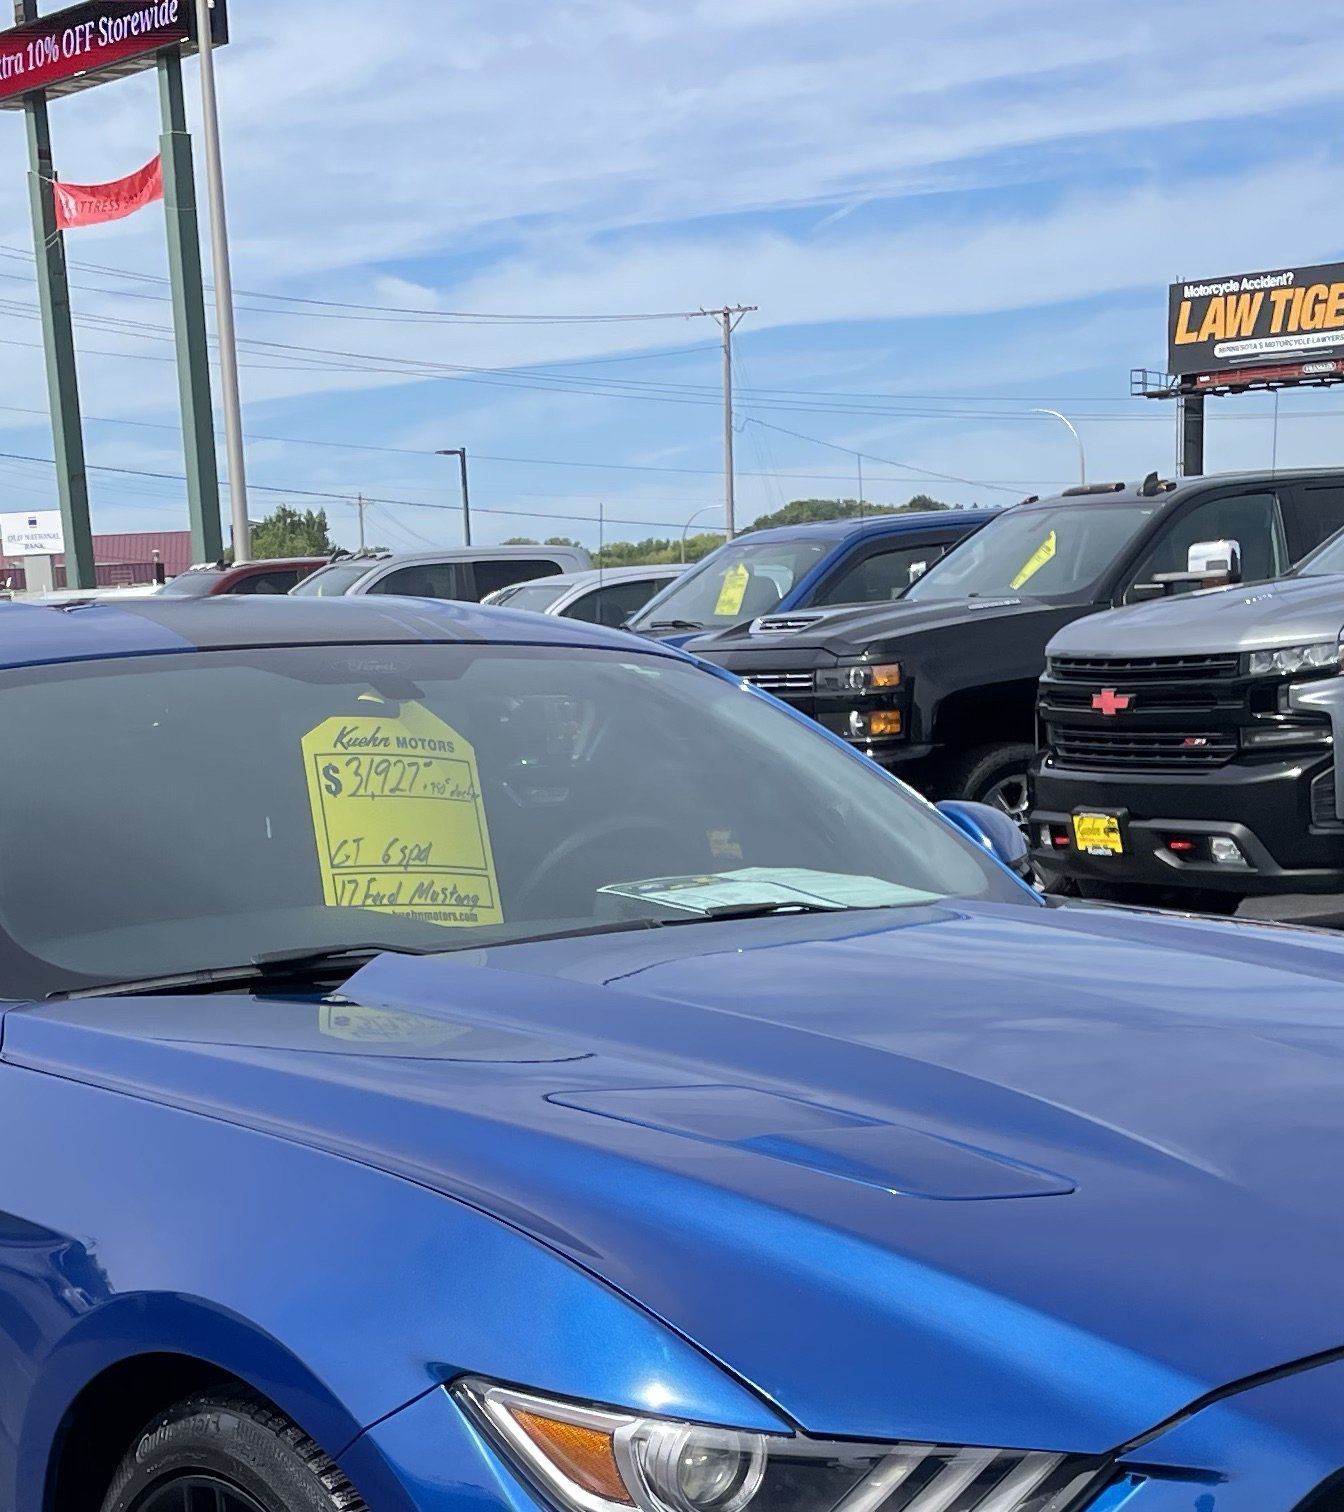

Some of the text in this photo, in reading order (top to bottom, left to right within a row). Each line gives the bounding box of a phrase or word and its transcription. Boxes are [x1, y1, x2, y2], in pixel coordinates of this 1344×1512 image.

[26, 33, 60, 71] 10%
[62, 20, 95, 58] OFF
[97, 0, 179, 48] Storewide
[1183, 271, 1295, 299] Motorcycle Accident?
[1174, 291, 1265, 345] LAW
[1264, 337, 1310, 350] MOTORCYCLE
[1311, 333, 1344, 345] LAWYERS
[333, 726, 456, 753] Kuehn MOTORS
[362, 877, 403, 906] Ford
[408, 879, 481, 912] Mustang
